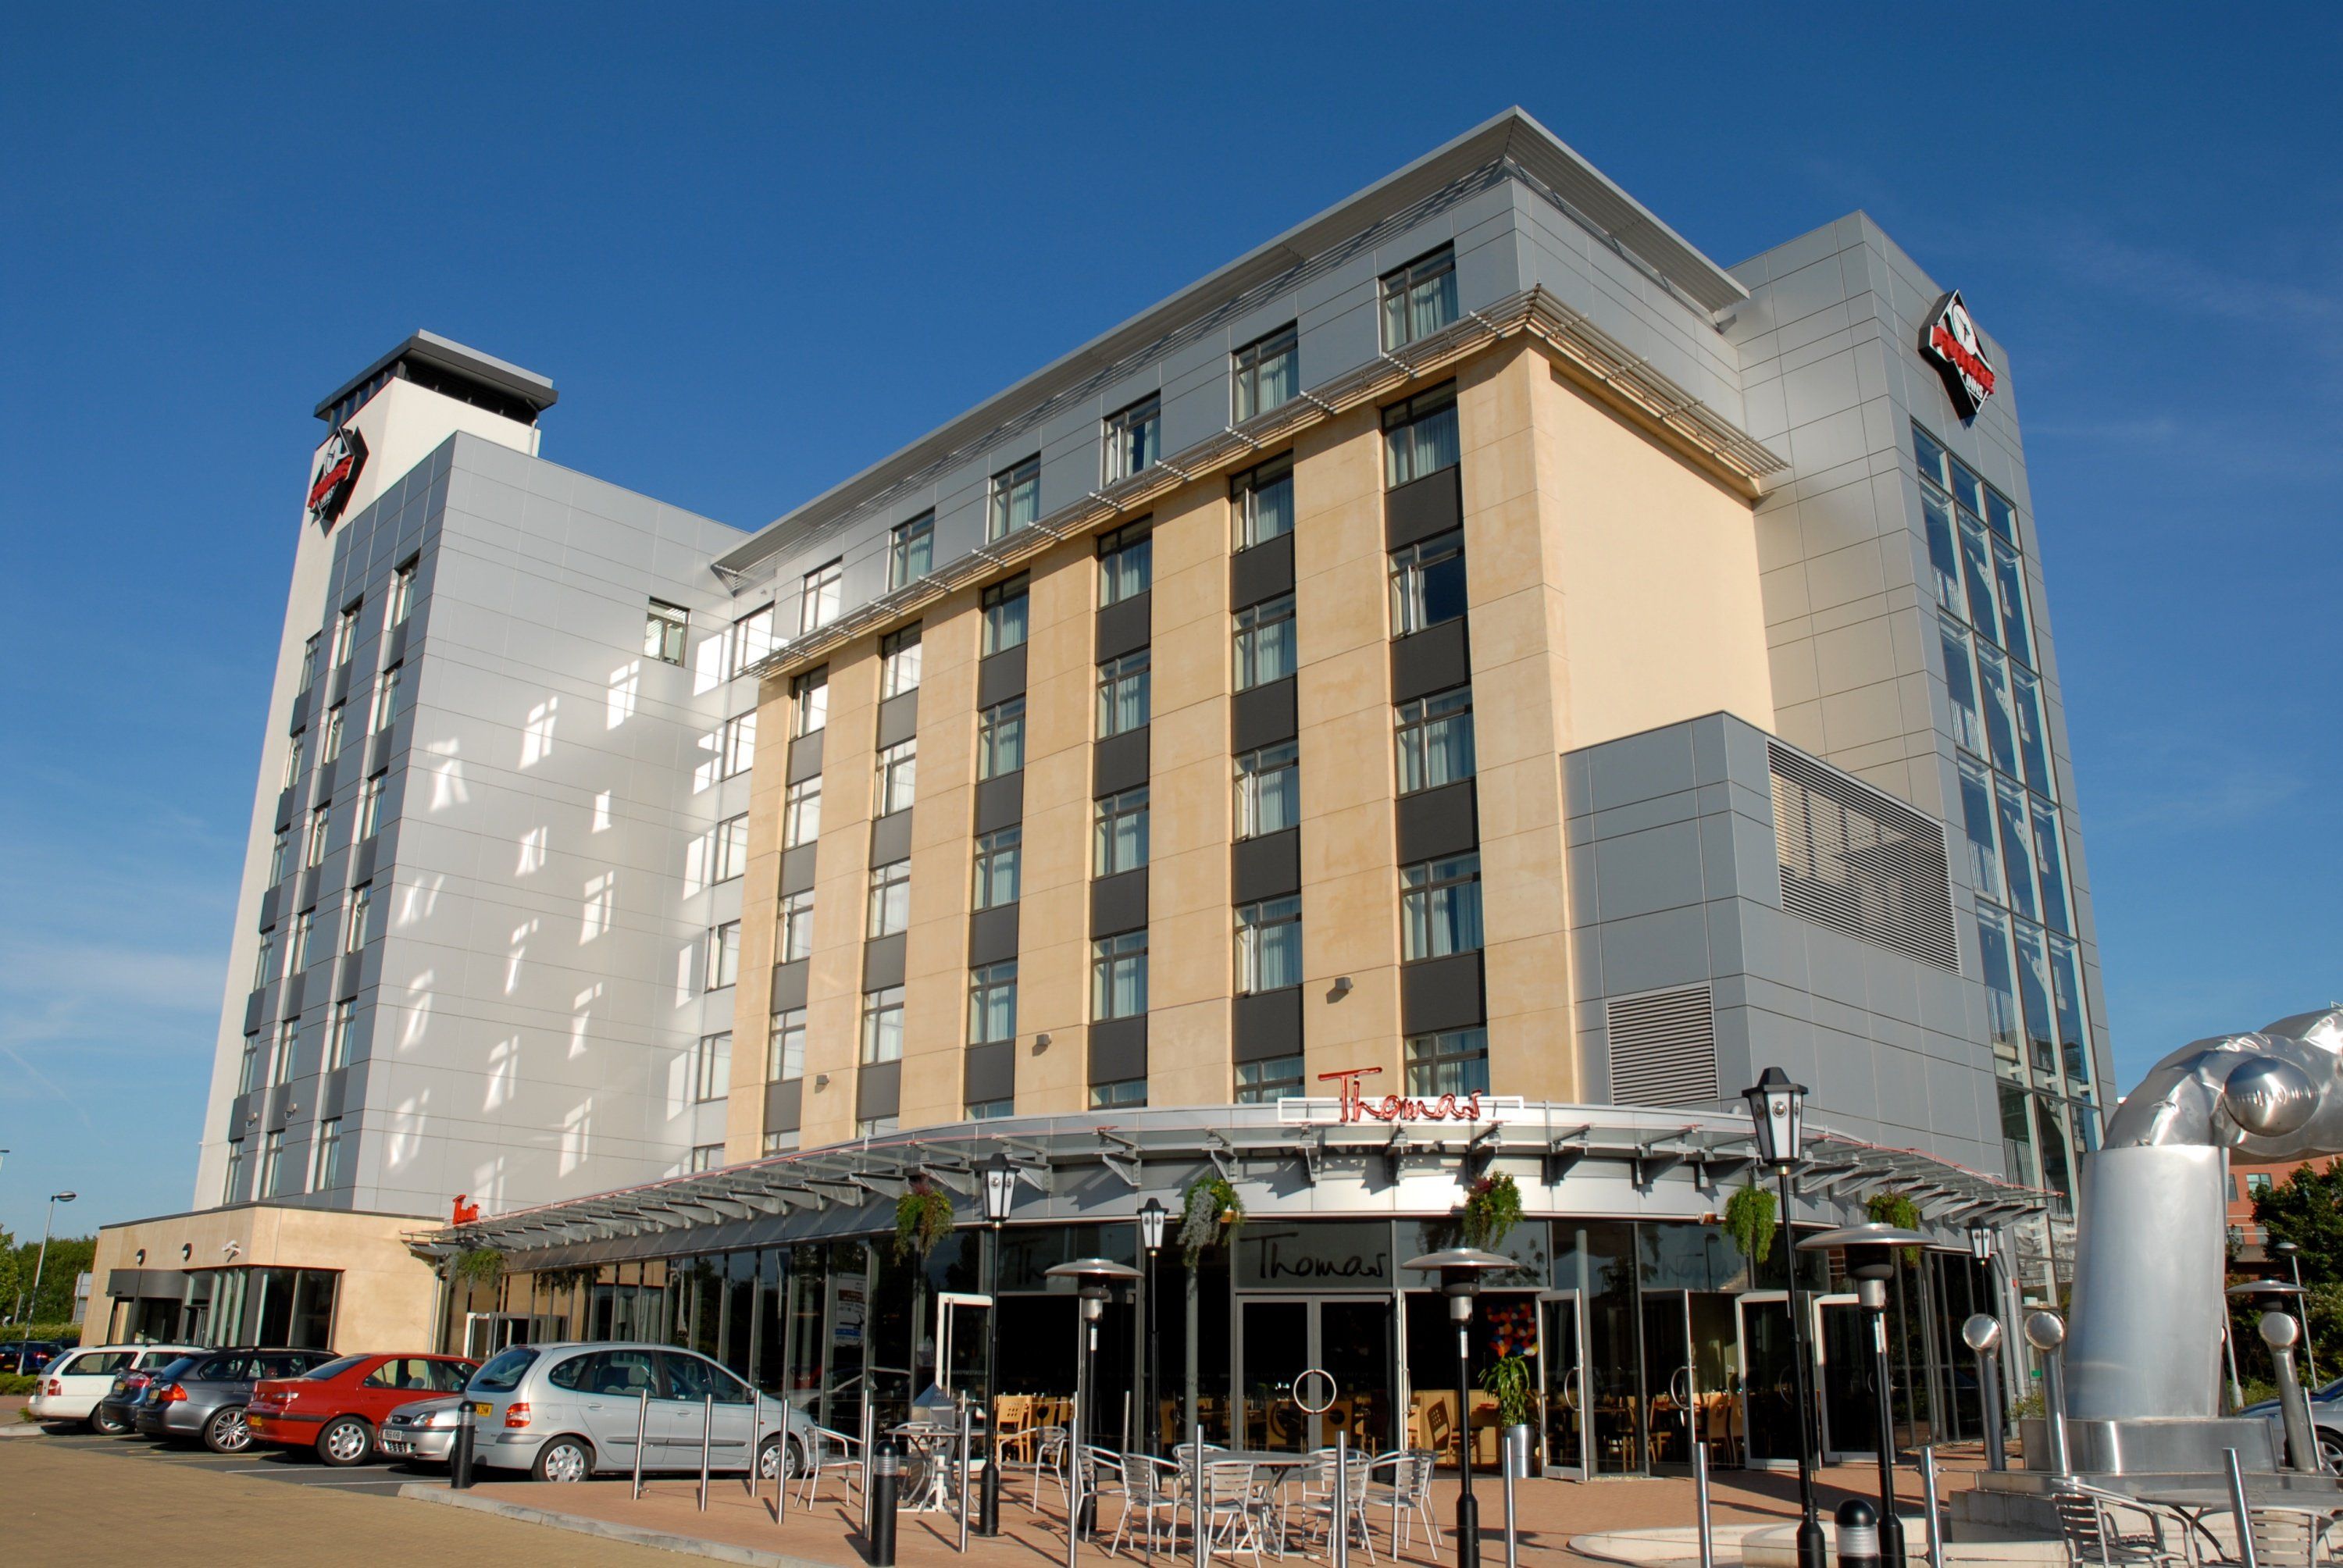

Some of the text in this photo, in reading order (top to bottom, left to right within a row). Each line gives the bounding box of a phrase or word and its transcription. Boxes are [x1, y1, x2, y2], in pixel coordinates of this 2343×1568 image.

[1966, 373, 1984, 399] INNS
[1318, 1067, 1482, 1123] Thomas
[1239, 1231, 1387, 1280] Thomas
